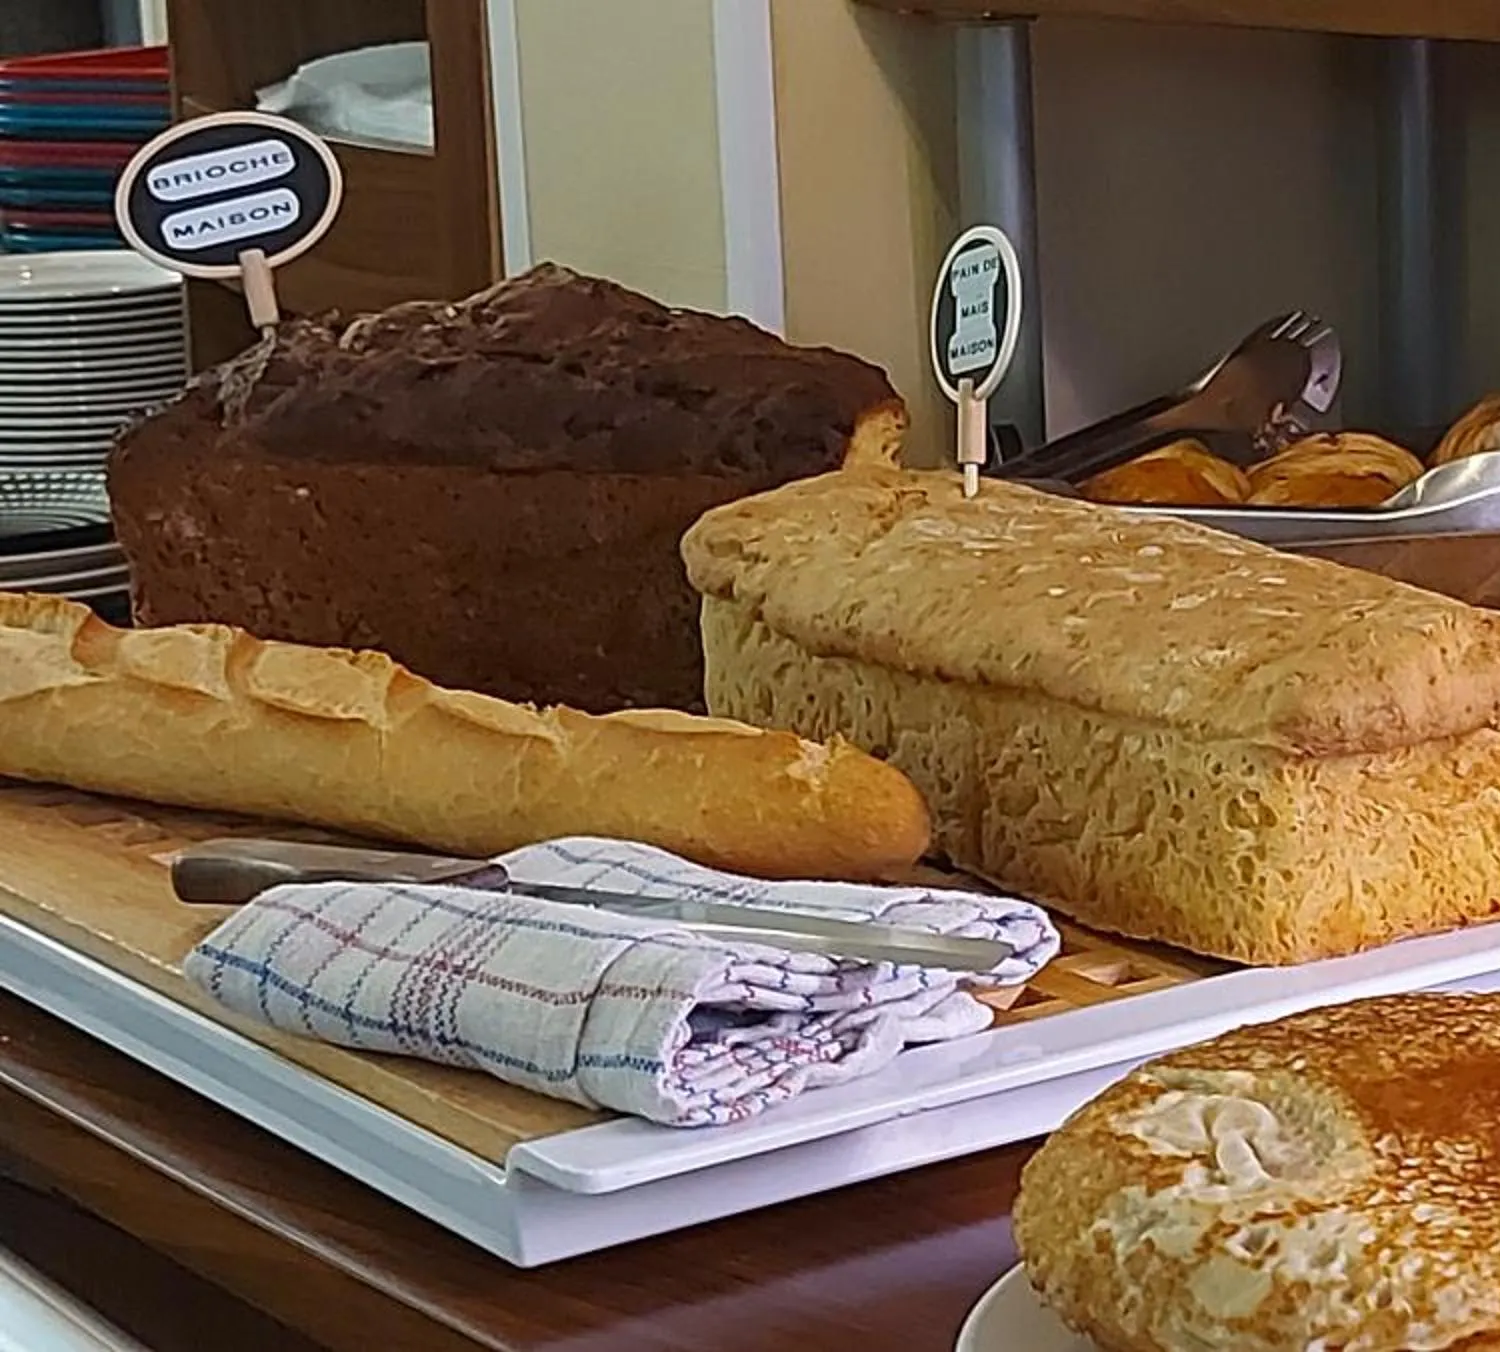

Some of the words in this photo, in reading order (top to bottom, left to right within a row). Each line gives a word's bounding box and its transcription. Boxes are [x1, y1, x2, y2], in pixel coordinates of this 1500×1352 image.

[152, 151, 291, 190] BRIOCHE
[172, 201, 292, 239] MAISON
[951, 338, 994, 359] MAISON
